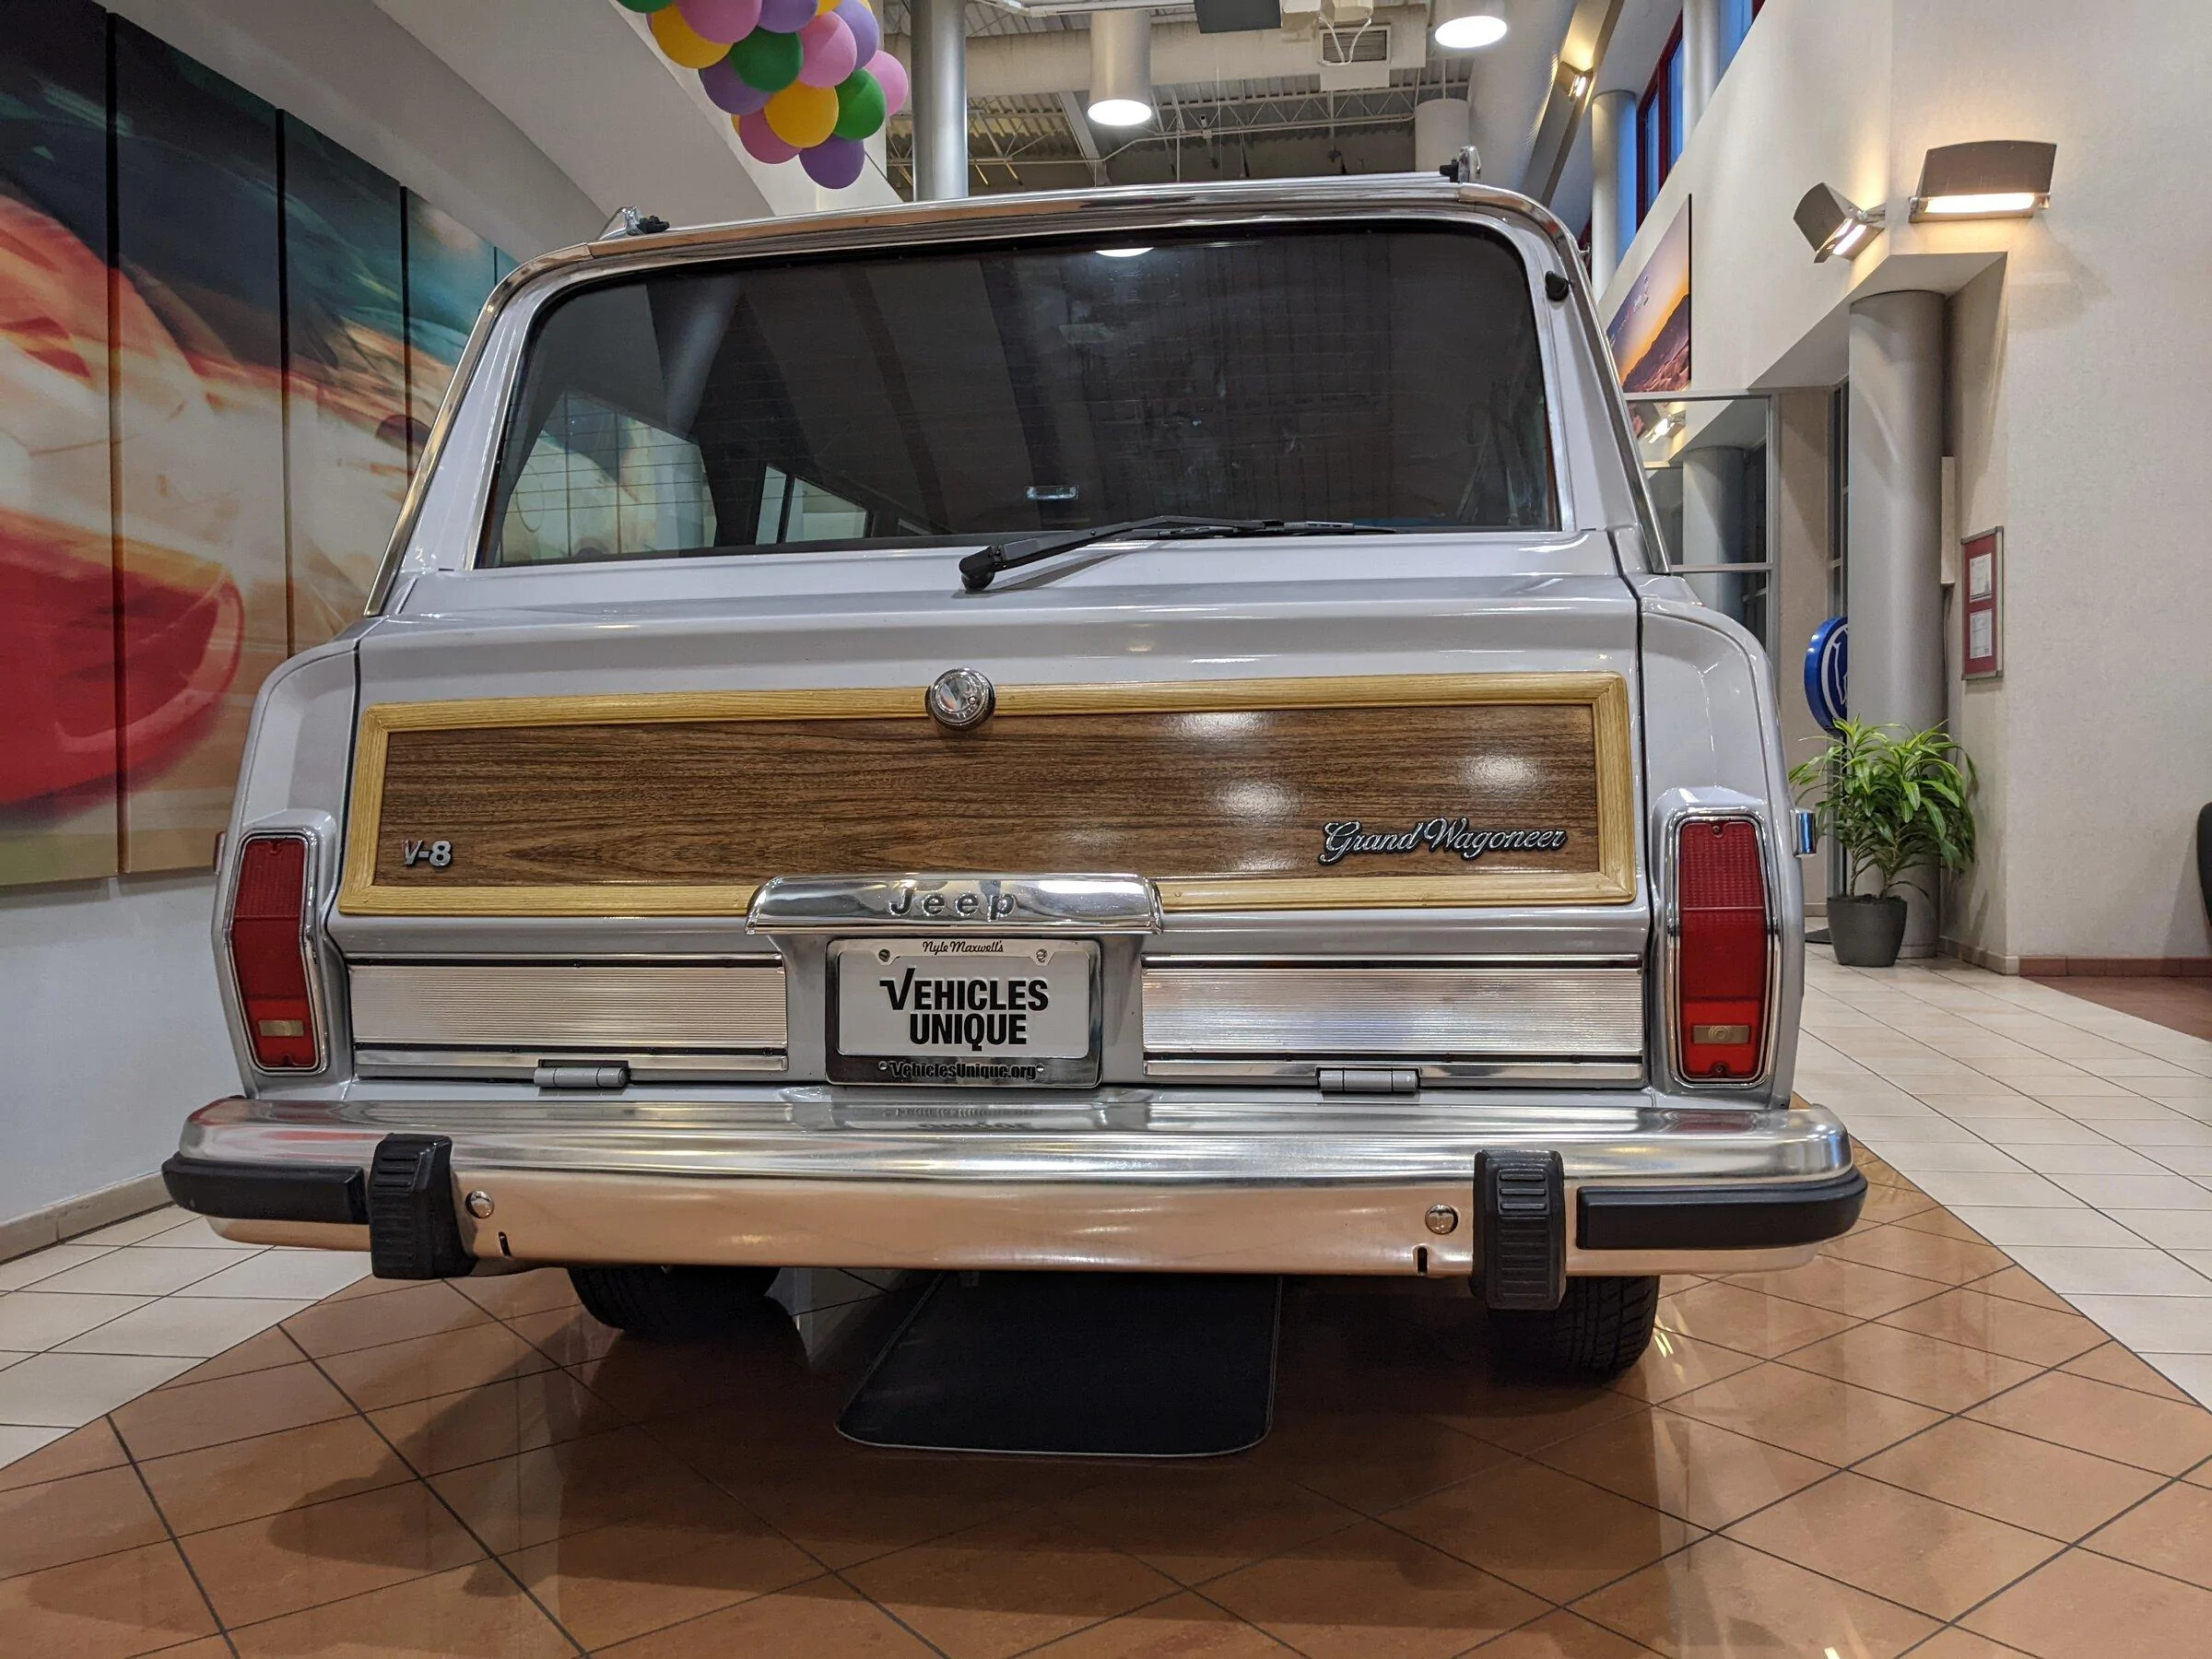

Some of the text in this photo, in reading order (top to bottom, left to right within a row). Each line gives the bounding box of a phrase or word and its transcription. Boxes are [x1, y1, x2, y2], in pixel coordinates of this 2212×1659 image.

[401, 839, 453, 867] V-8
[1318, 817, 1568, 865] Grand Wagoneer
[888, 886, 1015, 922] Jeep
[923, 940, 1004, 955] Nyle Maxwell's
[879, 968, 1049, 1011] VEHICLES
[910, 1013, 1027, 1052] UNIQUE
[890, 1061, 1037, 1080] VehiclesUnique.org
